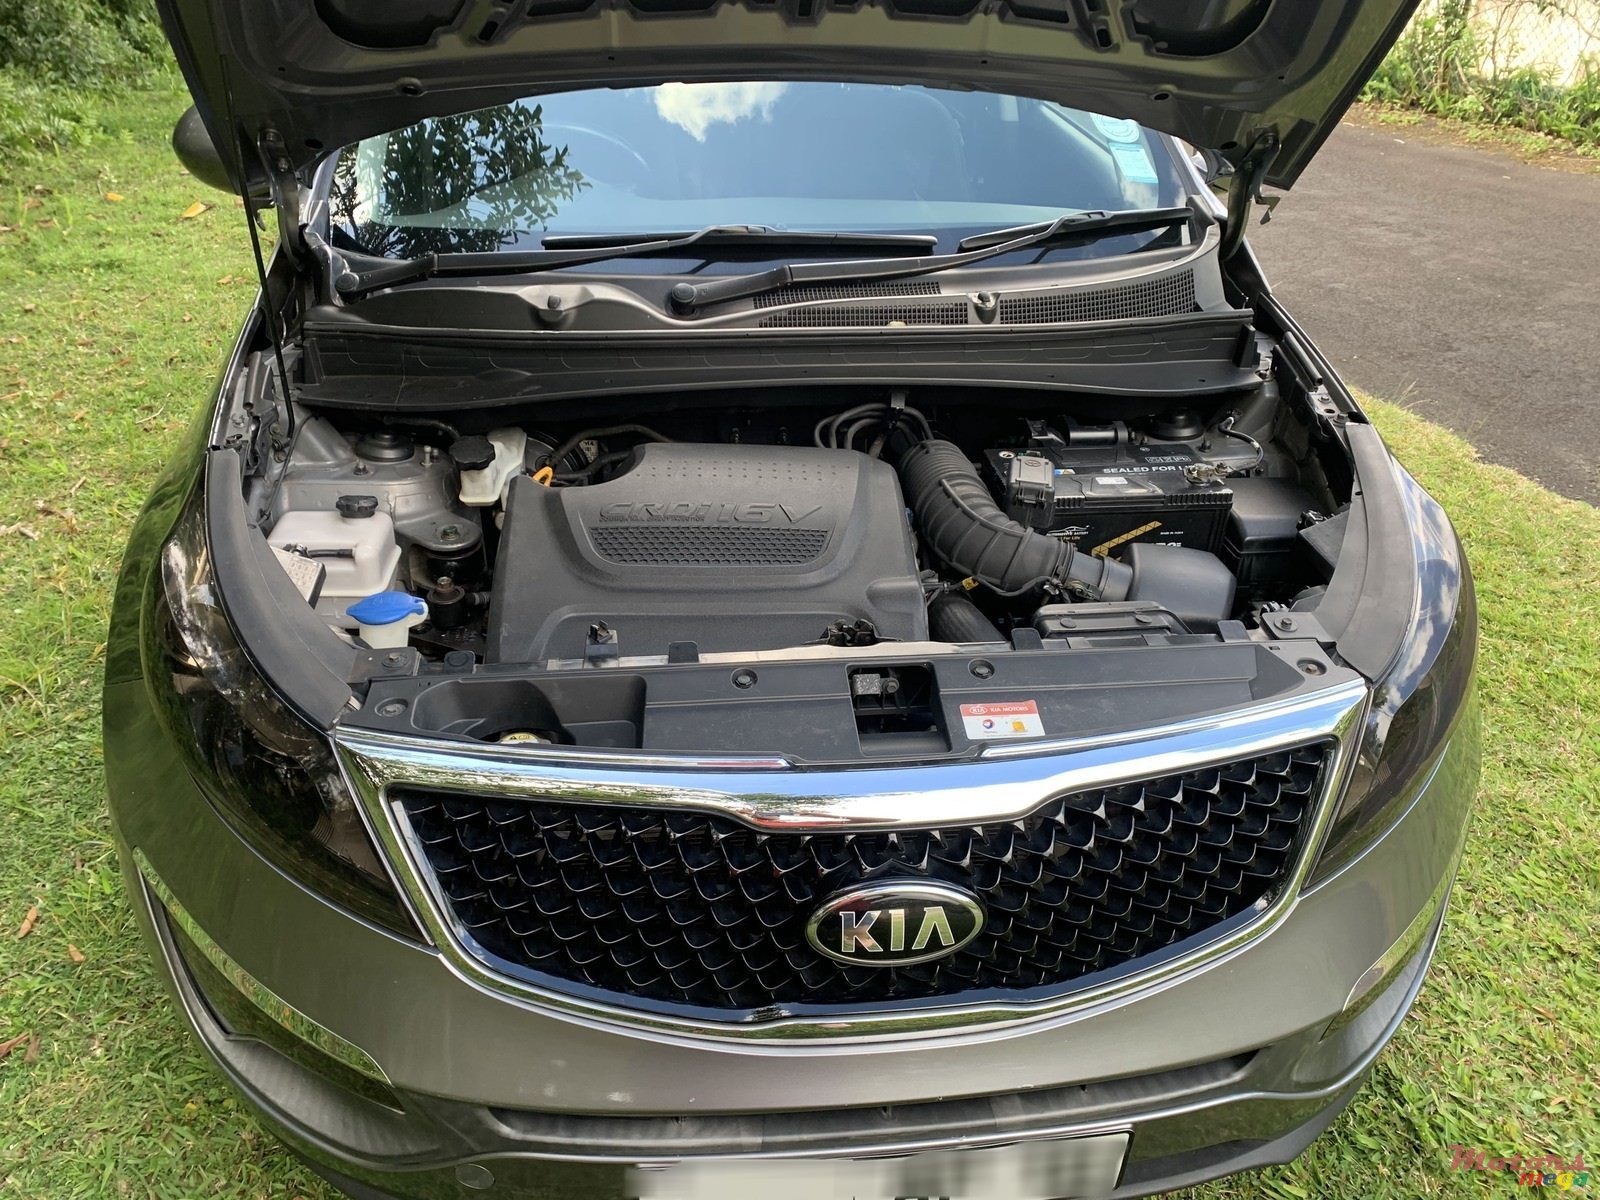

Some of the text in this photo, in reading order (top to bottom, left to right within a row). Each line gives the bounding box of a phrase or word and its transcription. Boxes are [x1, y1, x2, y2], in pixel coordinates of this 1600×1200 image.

[1103, 466, 1150, 474] SEALED
[716, 502, 824, 523] 16V
[1002, 705, 1029, 713] MOTORS
[838, 905, 956, 953] KIA
